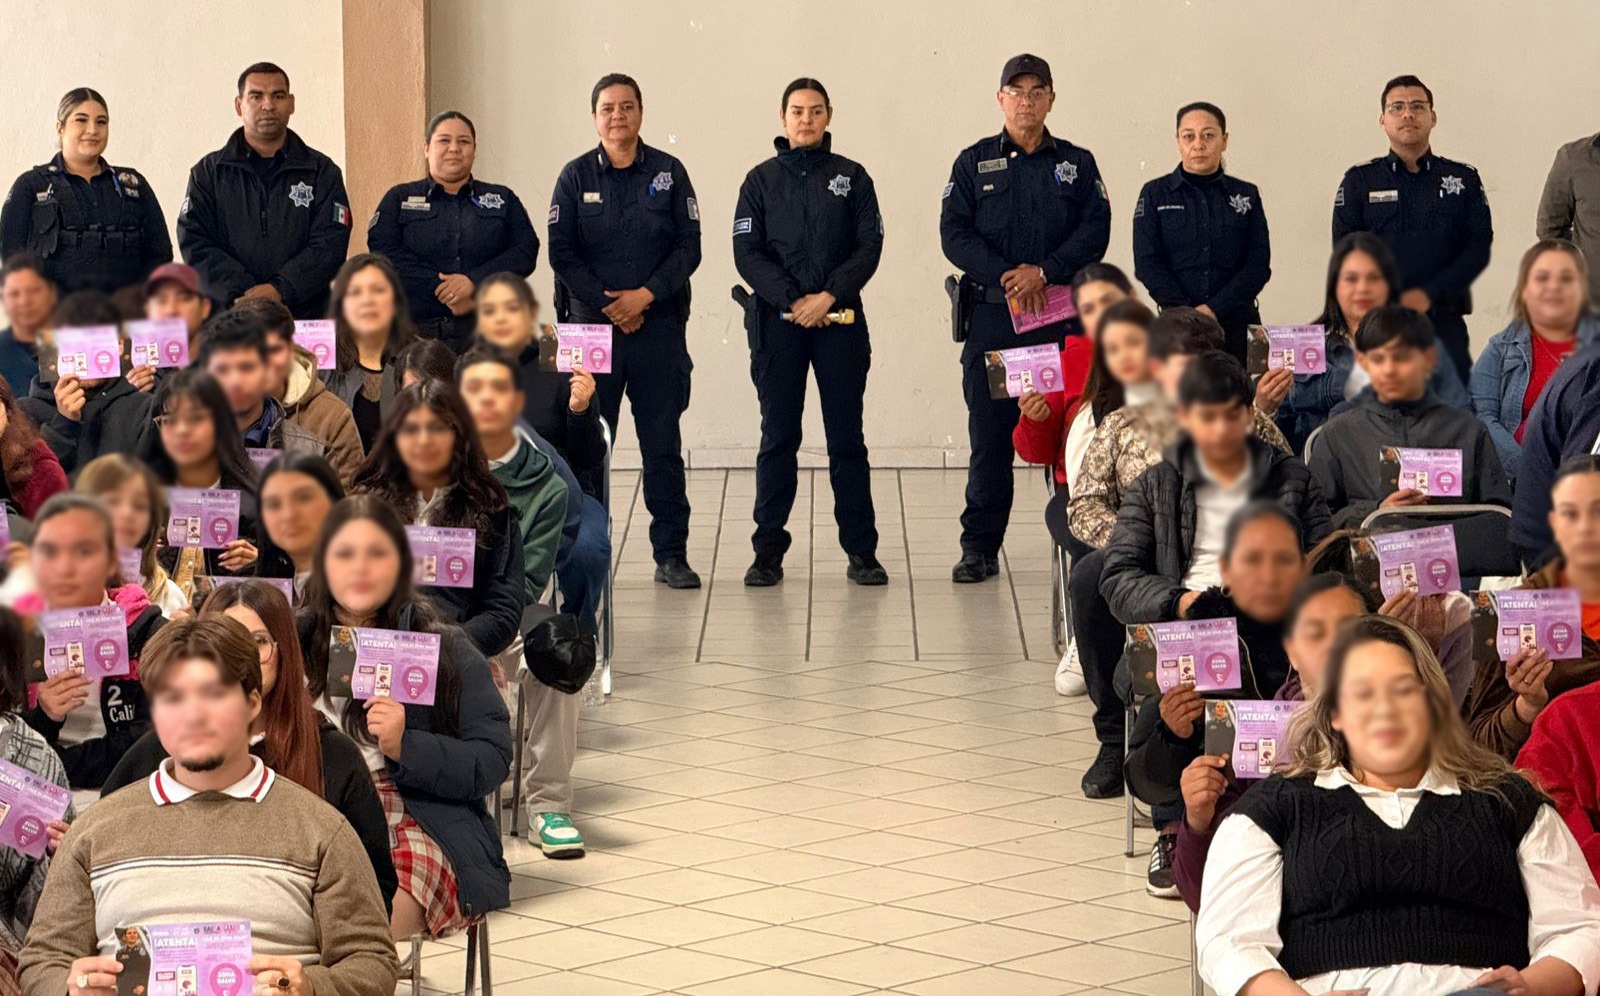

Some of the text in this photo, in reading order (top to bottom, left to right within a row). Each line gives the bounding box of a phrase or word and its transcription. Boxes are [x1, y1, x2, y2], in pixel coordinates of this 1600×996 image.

[1501, 600, 1537, 609] ¡ATENTA!
[1158, 632, 1194, 641] ¡ATENTA!
[361, 639, 397, 649] ¡ATENTA!
[107, 684, 123, 706] 2
[1239, 712, 1279, 721] ¡ATENTA!
[154, 936, 198, 947] ¡ATENTA!
